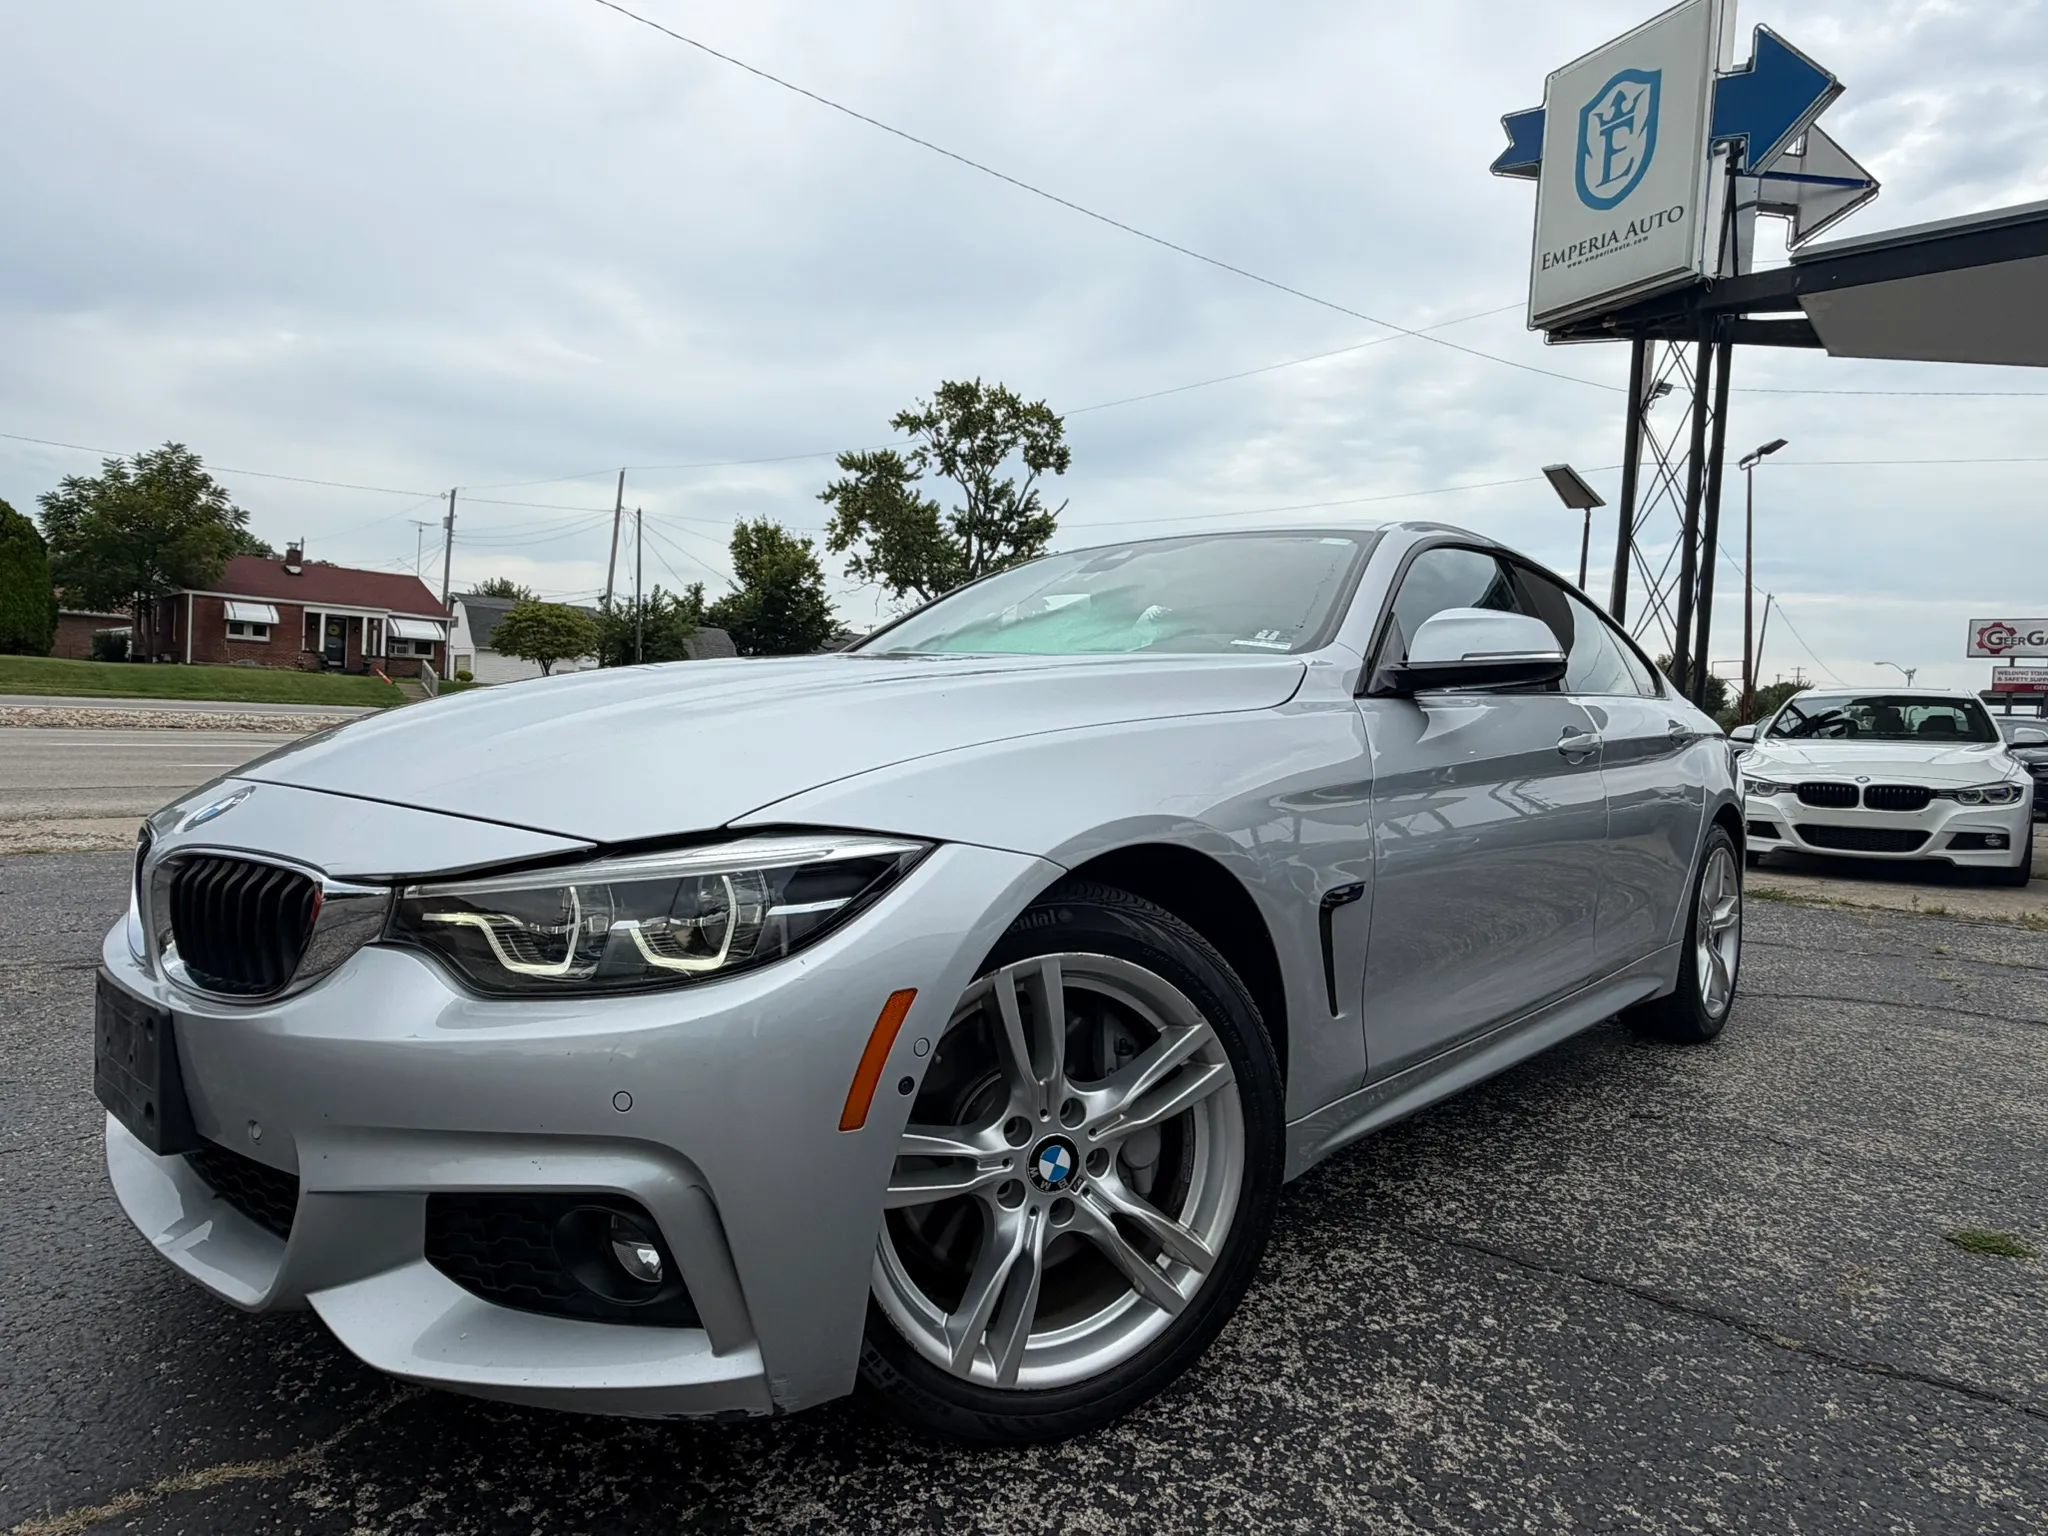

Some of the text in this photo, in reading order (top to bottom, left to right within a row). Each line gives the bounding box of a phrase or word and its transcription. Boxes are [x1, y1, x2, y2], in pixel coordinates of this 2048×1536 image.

[1541, 205, 1684, 271] EMPERIA AUTO
[1566, 235, 1649, 269] www.emperiaauto.com
